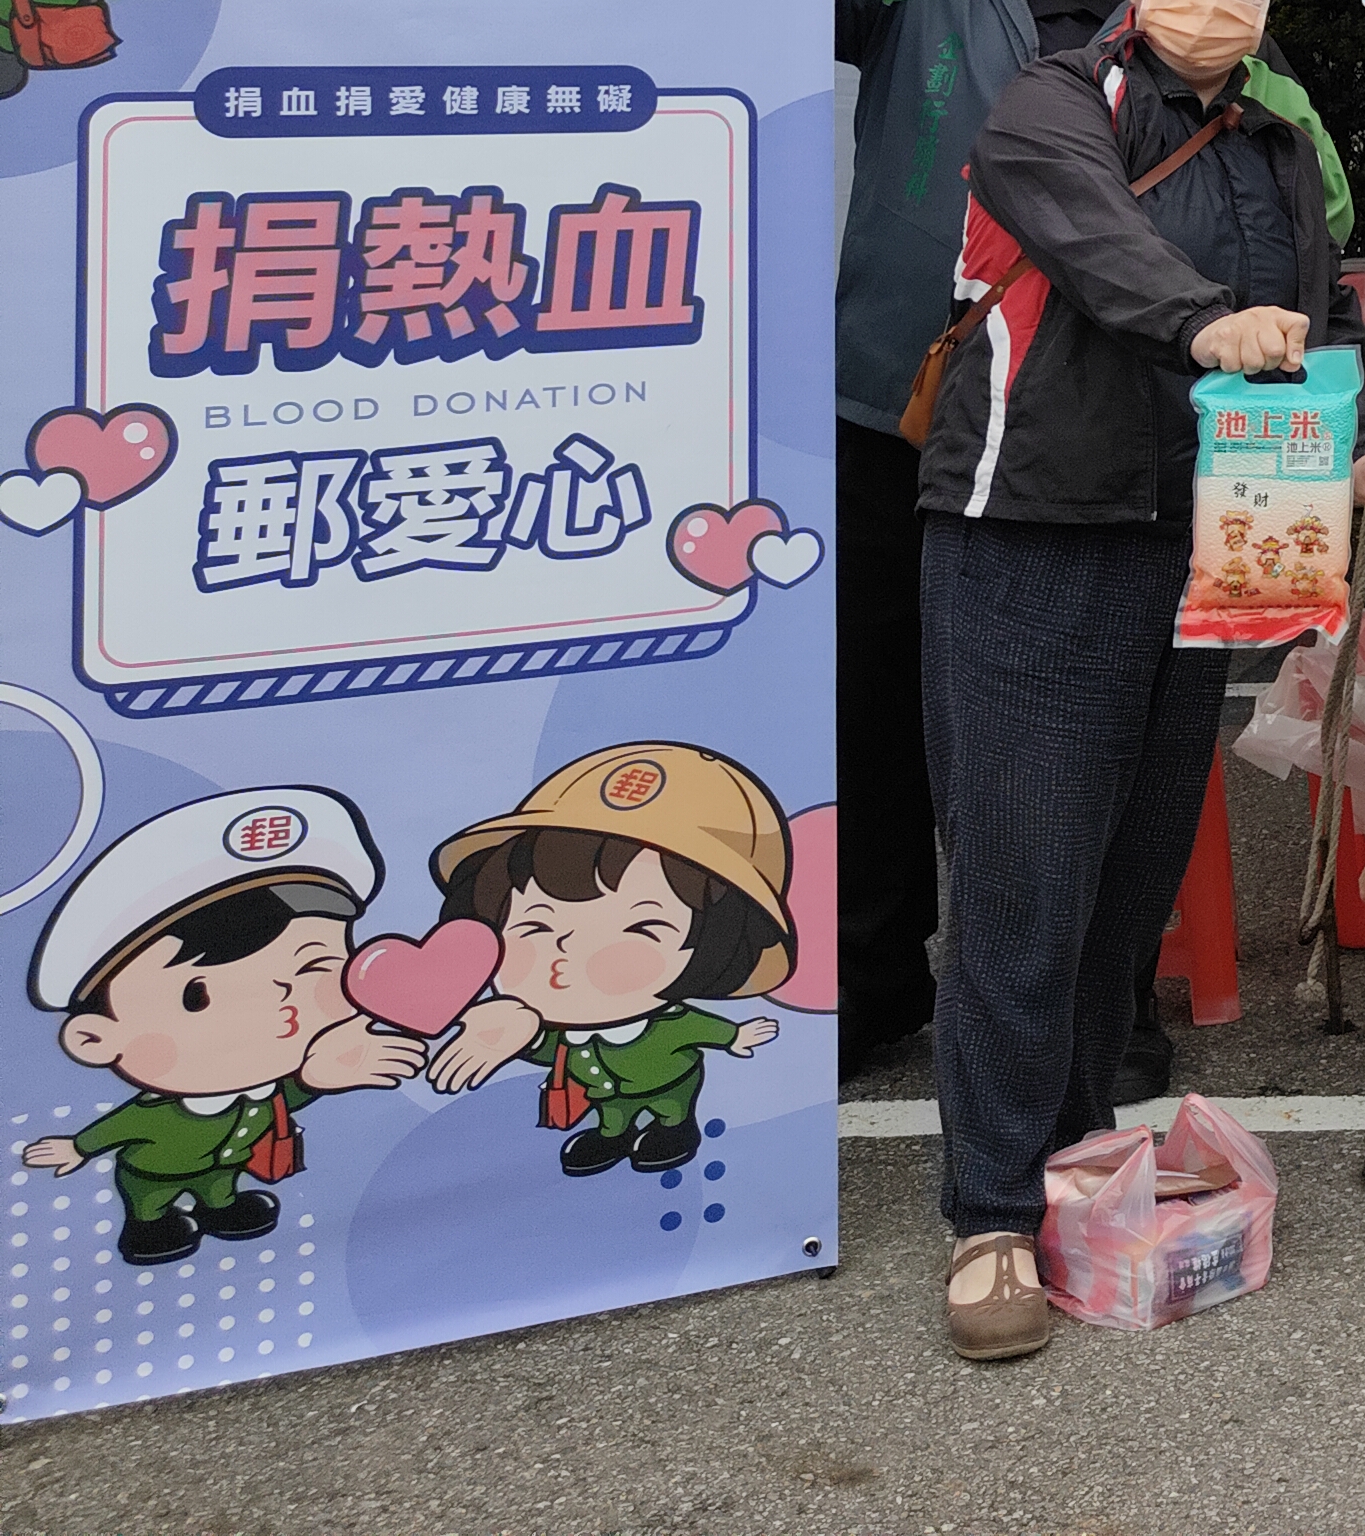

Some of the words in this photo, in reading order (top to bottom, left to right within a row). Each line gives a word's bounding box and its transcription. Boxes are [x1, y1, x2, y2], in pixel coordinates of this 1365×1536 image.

[225, 83, 633, 118] 捐血捐愛健康無礙
[155, 186, 699, 366] 捐熱血
[204, 396, 381, 429] BLOOD
[413, 380, 649, 418] DONATION
[1215, 410, 1321, 440] 池上米
[198, 436, 649, 588] 郵愛心
[1233, 482, 1269, 507] 發財
